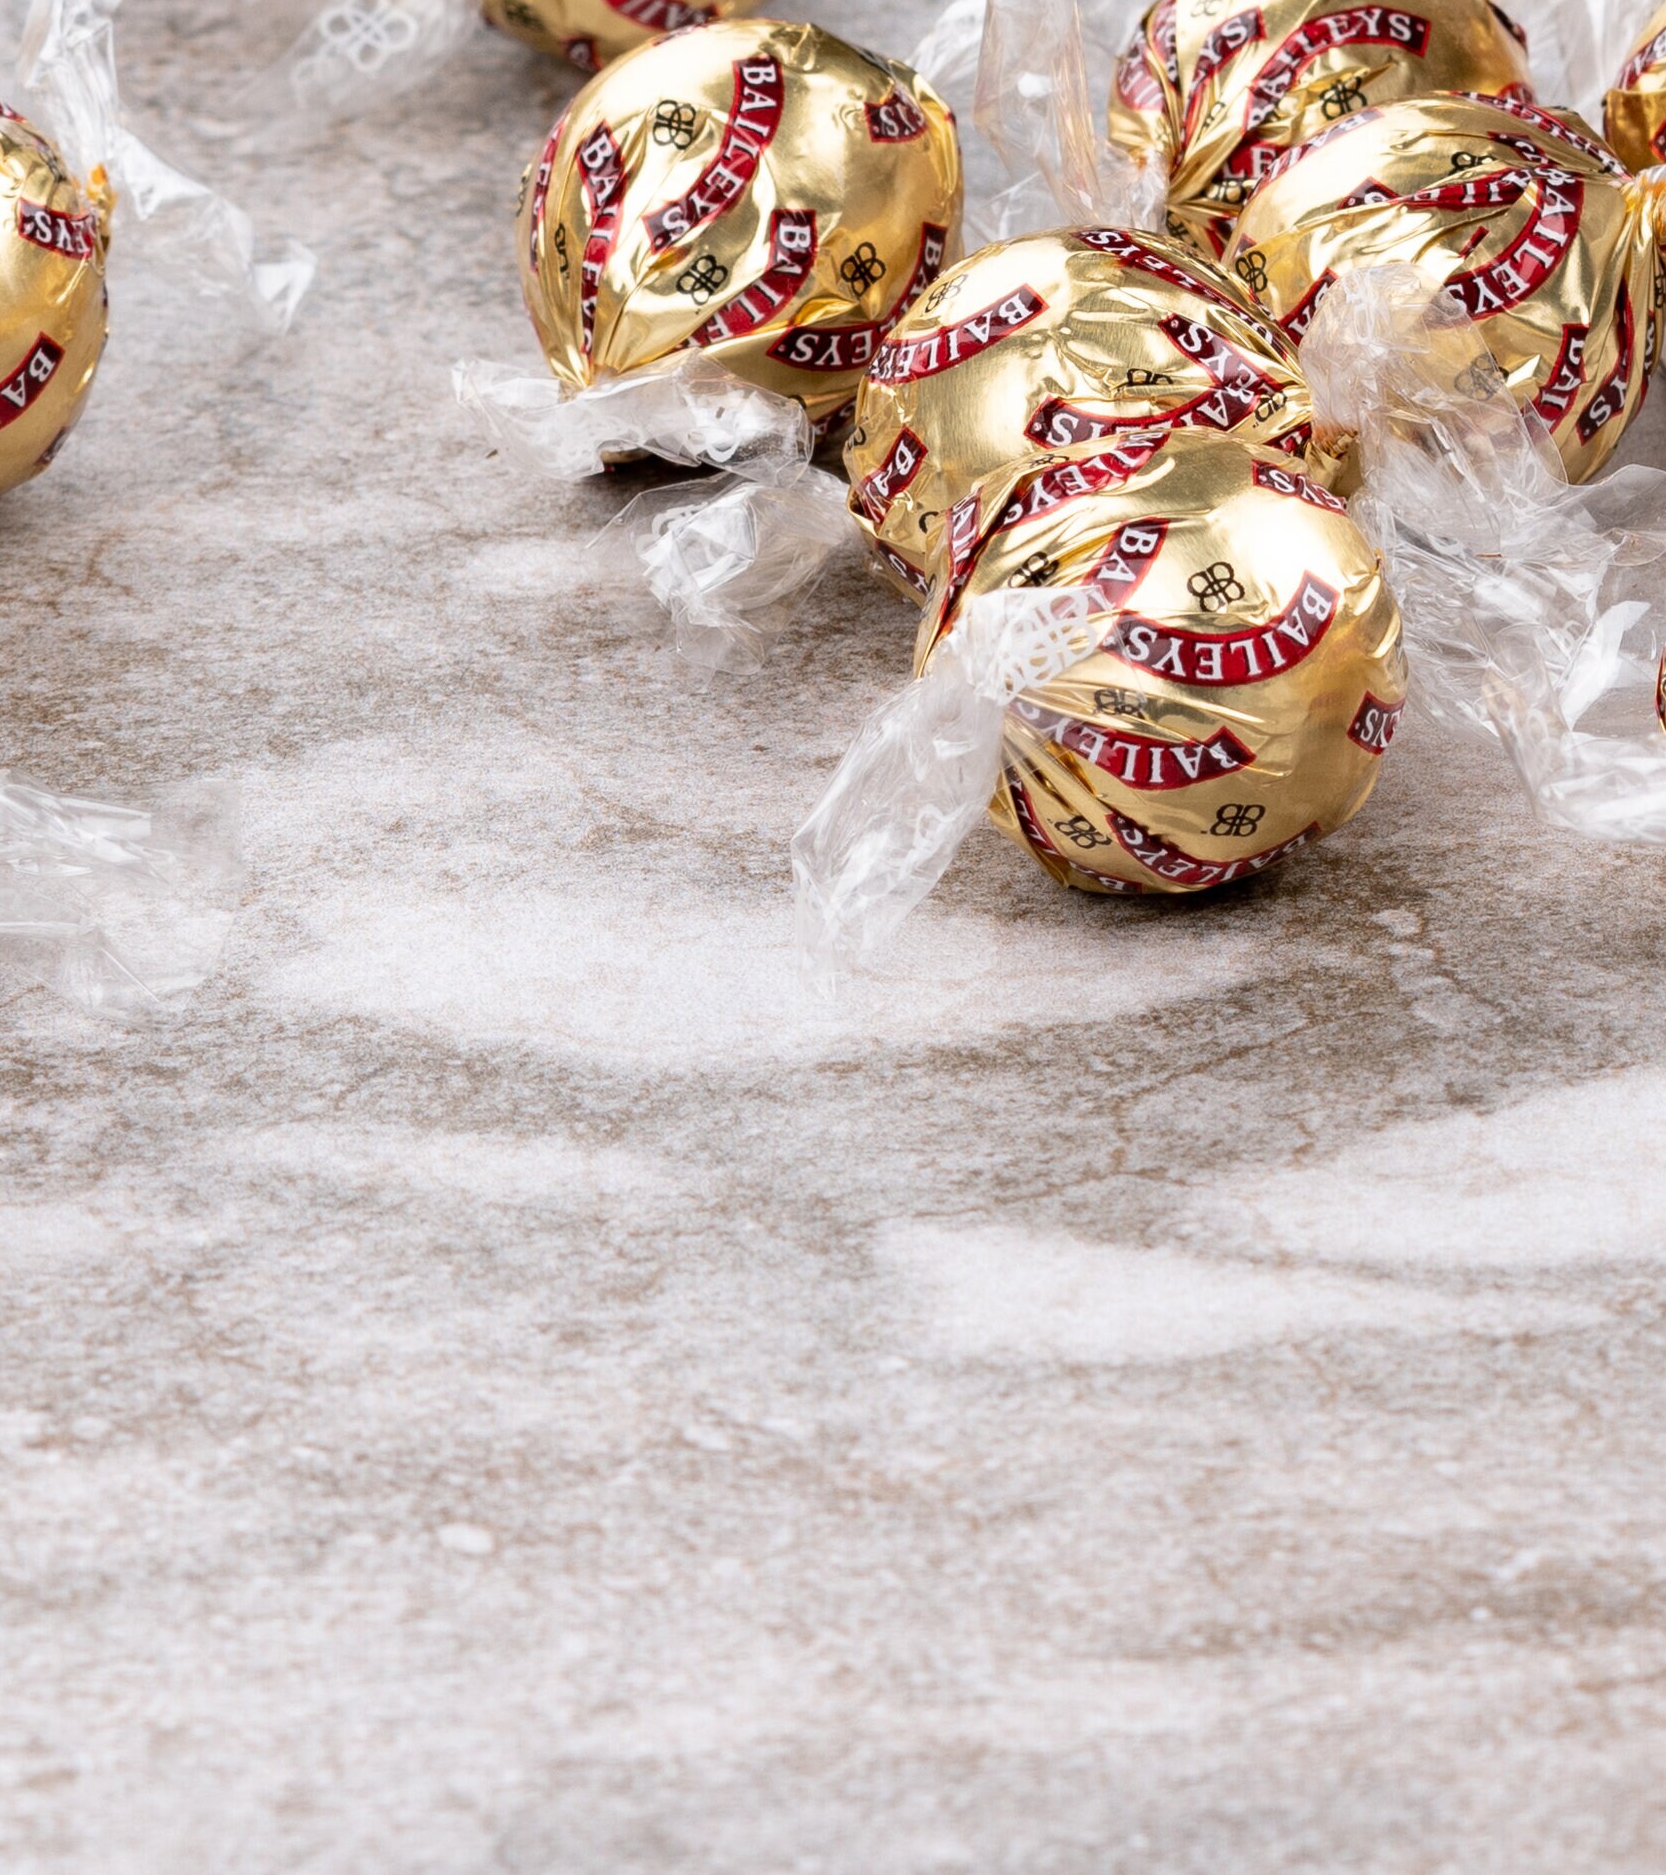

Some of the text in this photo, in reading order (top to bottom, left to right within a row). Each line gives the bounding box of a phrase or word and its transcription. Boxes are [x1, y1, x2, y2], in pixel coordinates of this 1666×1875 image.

[1250, 9, 1411, 128] BAILEYS
[662, 64, 777, 240] BAILEYS
[1125, 583, 1333, 680] BAILEYS
